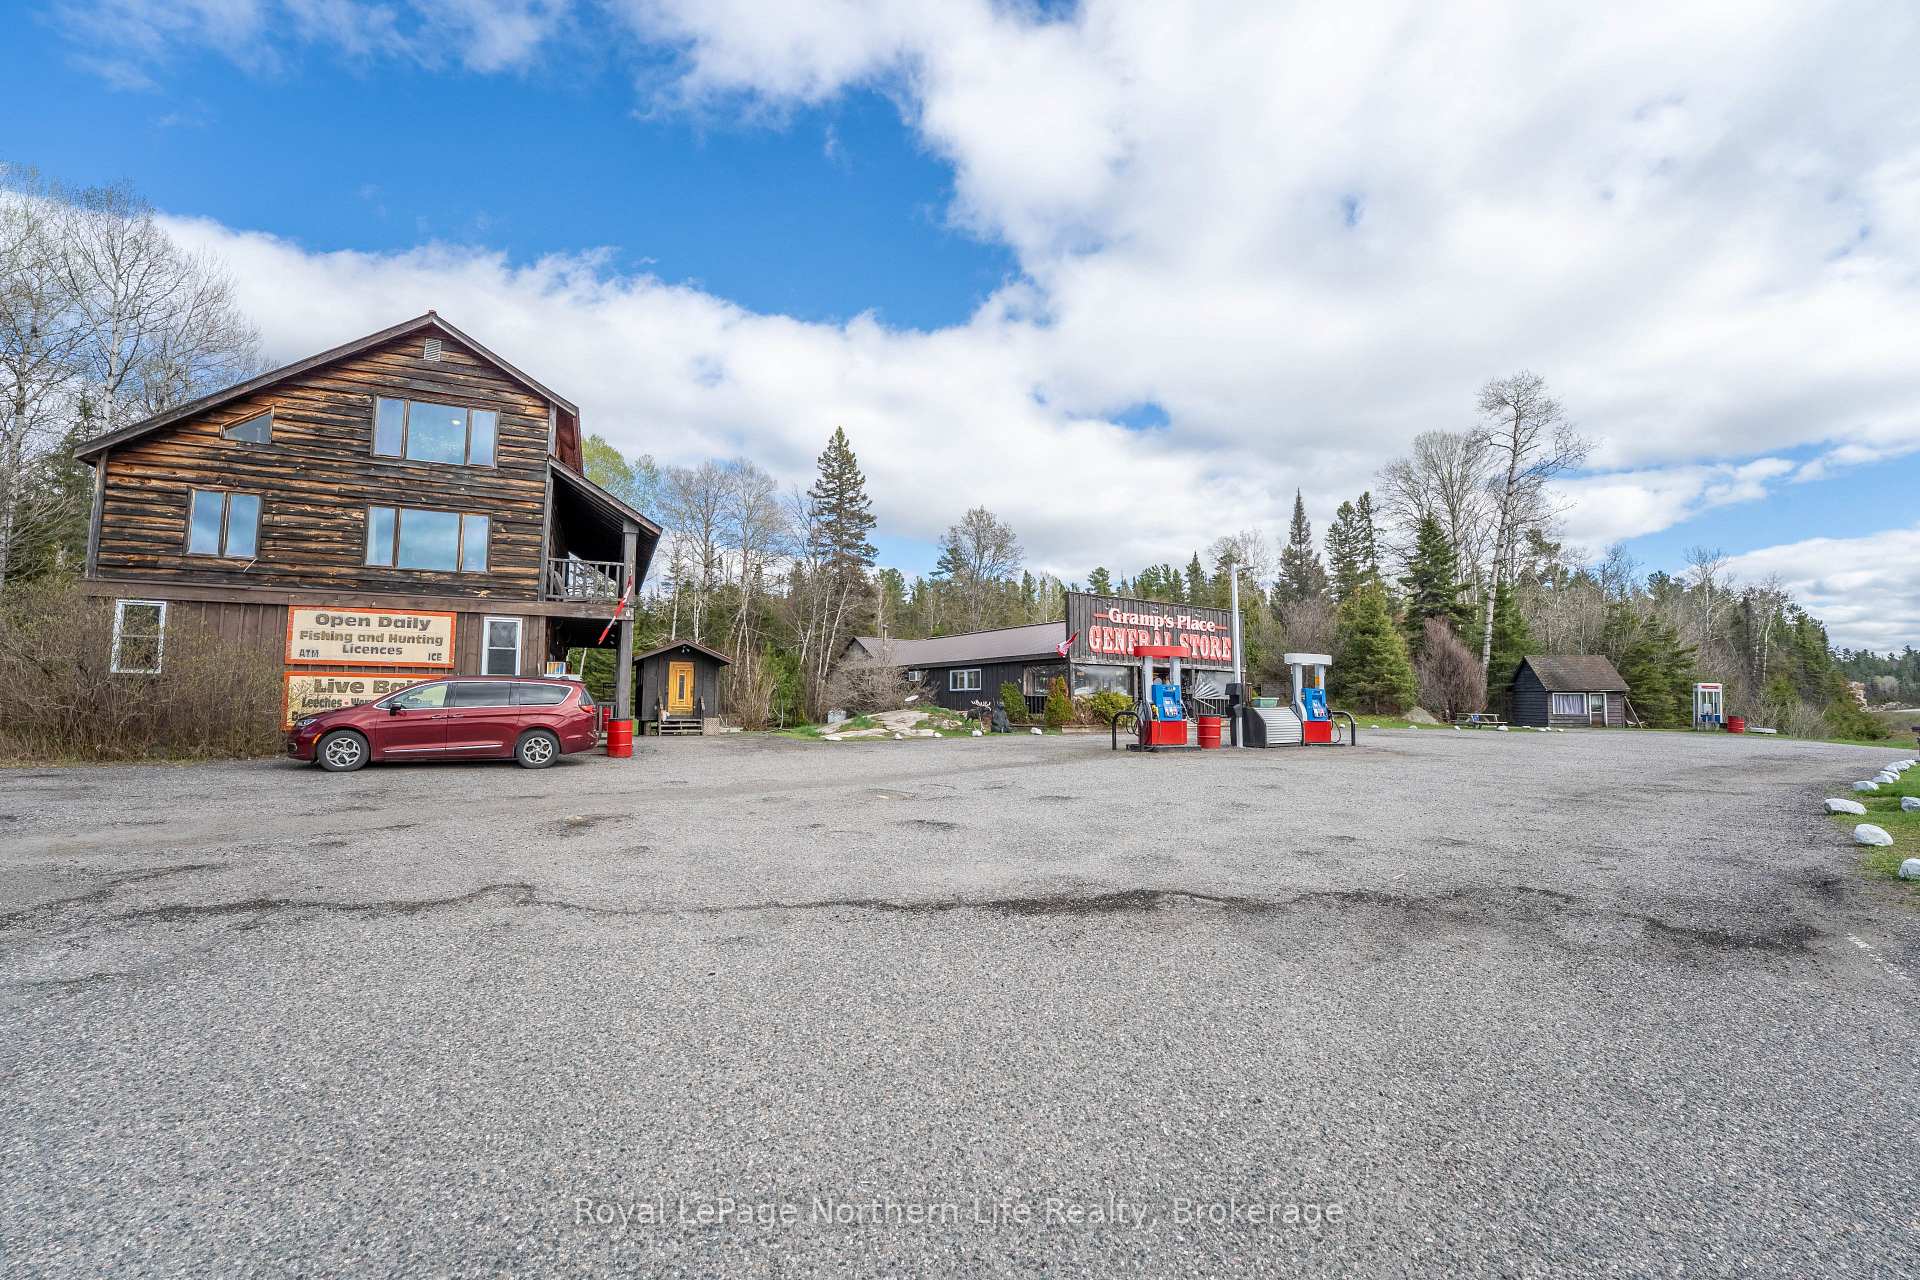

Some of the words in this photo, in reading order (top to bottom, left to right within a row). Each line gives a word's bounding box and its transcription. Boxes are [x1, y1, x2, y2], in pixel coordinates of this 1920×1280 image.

[315, 613, 371, 628] Open
[378, 616, 432, 632] Daily
[1108, 608, 1174, 631] Gramp's
[1177, 614, 1216, 632] Place
[299, 630, 353, 643] Fishing
[358, 633, 384, 643] and
[388, 633, 444, 647] Hunting
[299, 649, 319, 658] ATM
[342, 644, 403, 656] Licences
[1180, 633, 1232, 661] STORE
[428, 652, 443, 661] ICE
[314, 678, 365, 694] Live
[301, 696, 343, 708] Leeches
